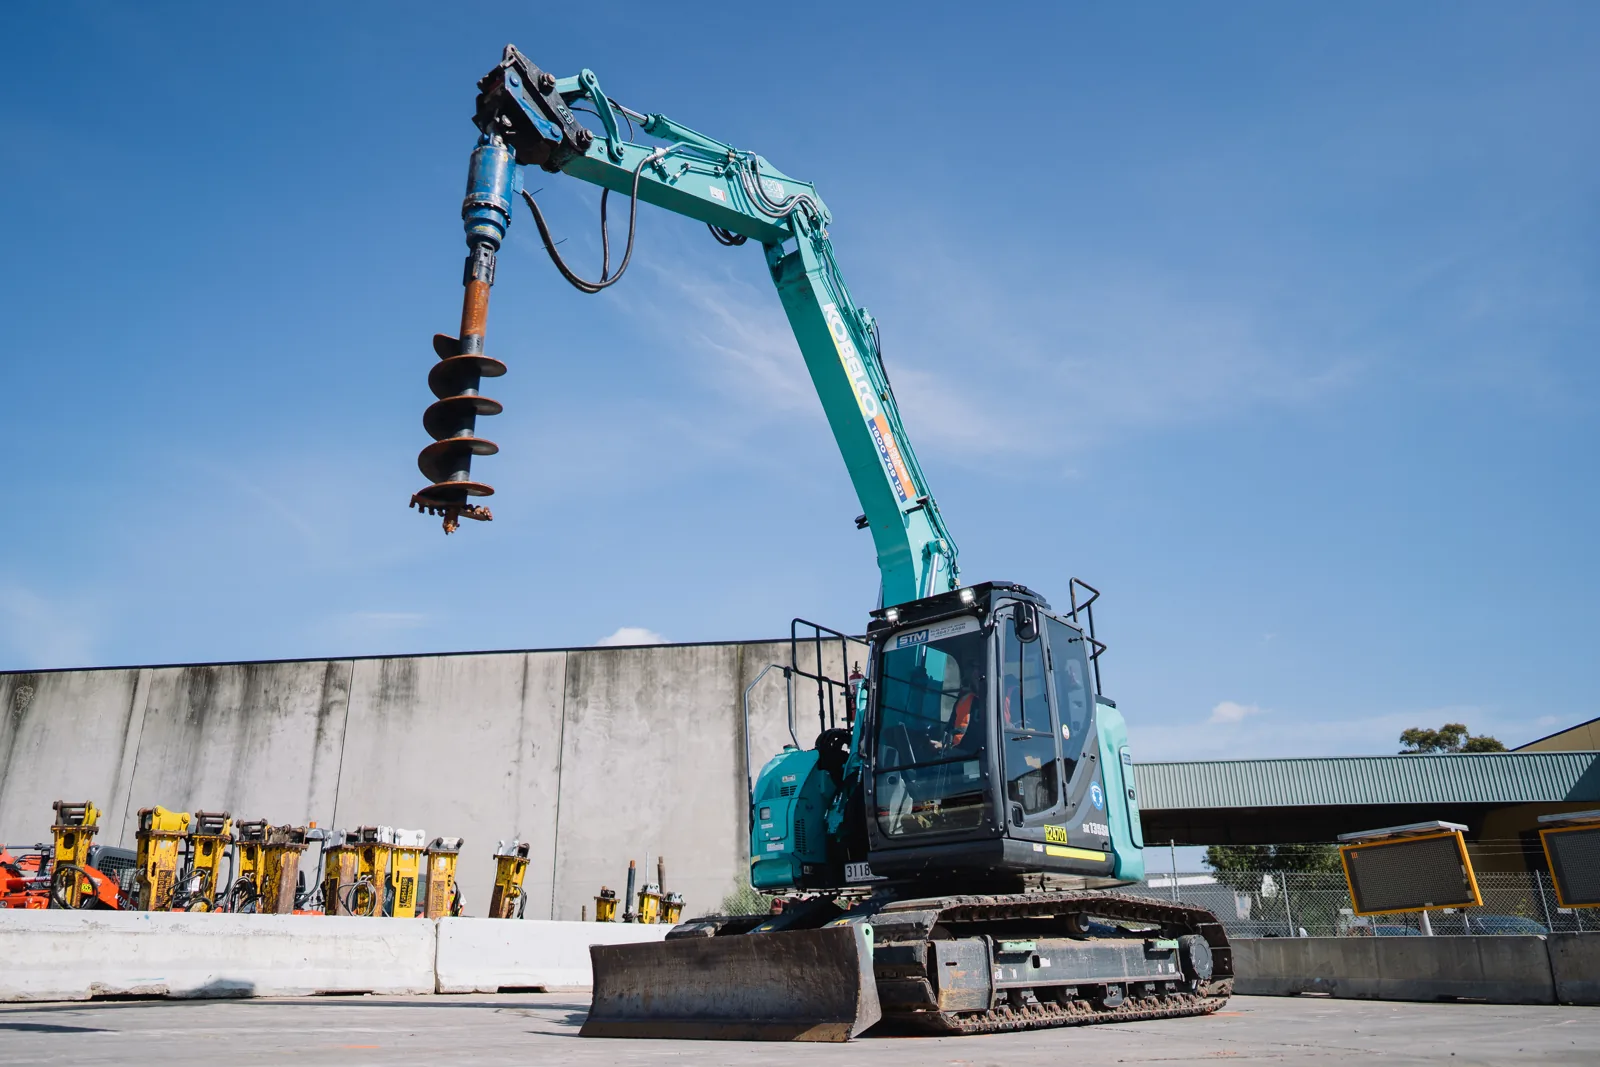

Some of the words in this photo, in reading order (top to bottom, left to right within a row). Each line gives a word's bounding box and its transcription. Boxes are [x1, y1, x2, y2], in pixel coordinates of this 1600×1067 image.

[822, 302, 878, 419] KOBELCO
[871, 424, 887, 454] 1800
[894, 478, 904, 497] 121
[899, 632, 926, 645] STM
[114, 892, 138, 911] KUO
